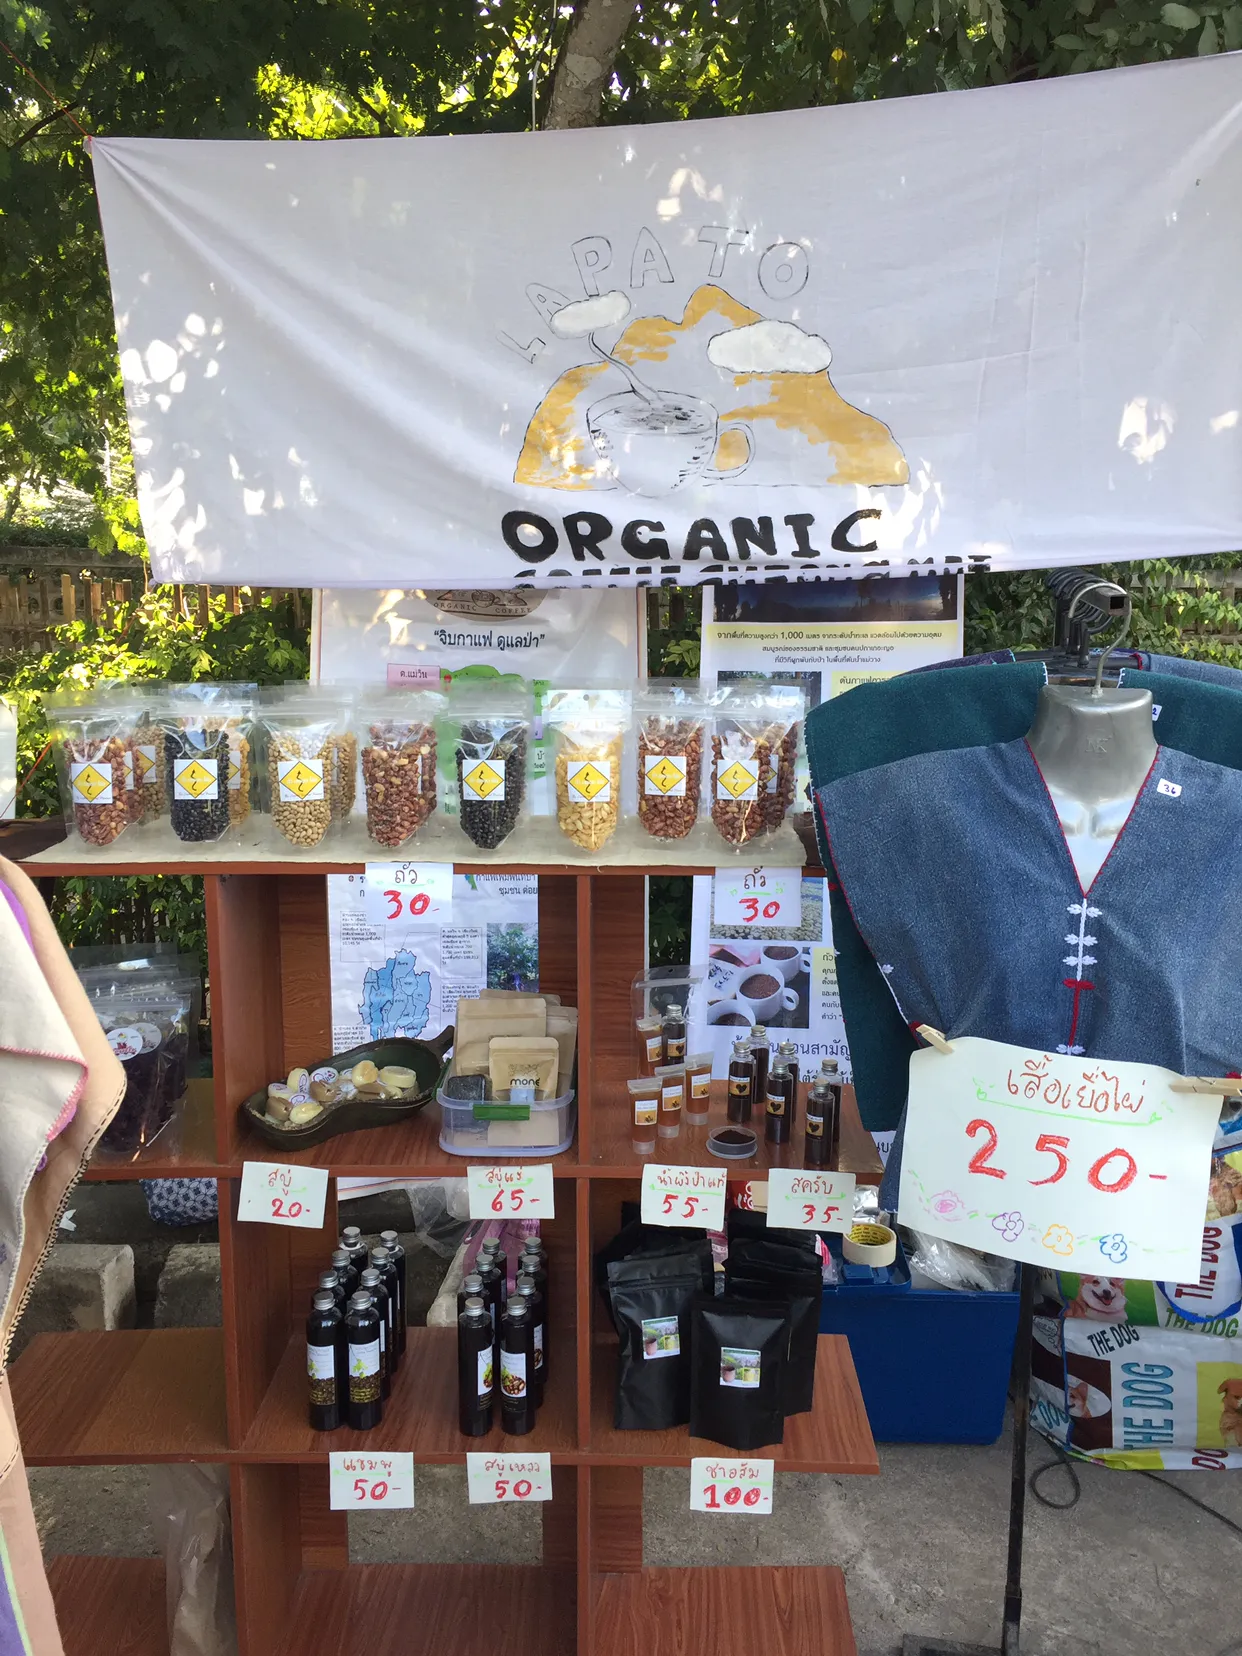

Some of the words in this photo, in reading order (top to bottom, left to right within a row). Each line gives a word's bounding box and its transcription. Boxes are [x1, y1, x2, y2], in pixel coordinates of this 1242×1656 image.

[501, 508, 882, 564] ORGANIC
[433, 602, 477, 612] ORGANIC
[434, 628, 493, 647] “จิบกาแฟ
[497, 631, 546, 651] ดูแลป่า”
[780, 631, 804, 641] 1,000
[738, 897, 781, 923] 30
[267, 1168, 293, 1196] สบู่
[1087, 1330, 1116, 1357] THE
[1113, 1322, 1141, 1351] DOG
[1121, 1361, 1174, 1411] DOG
